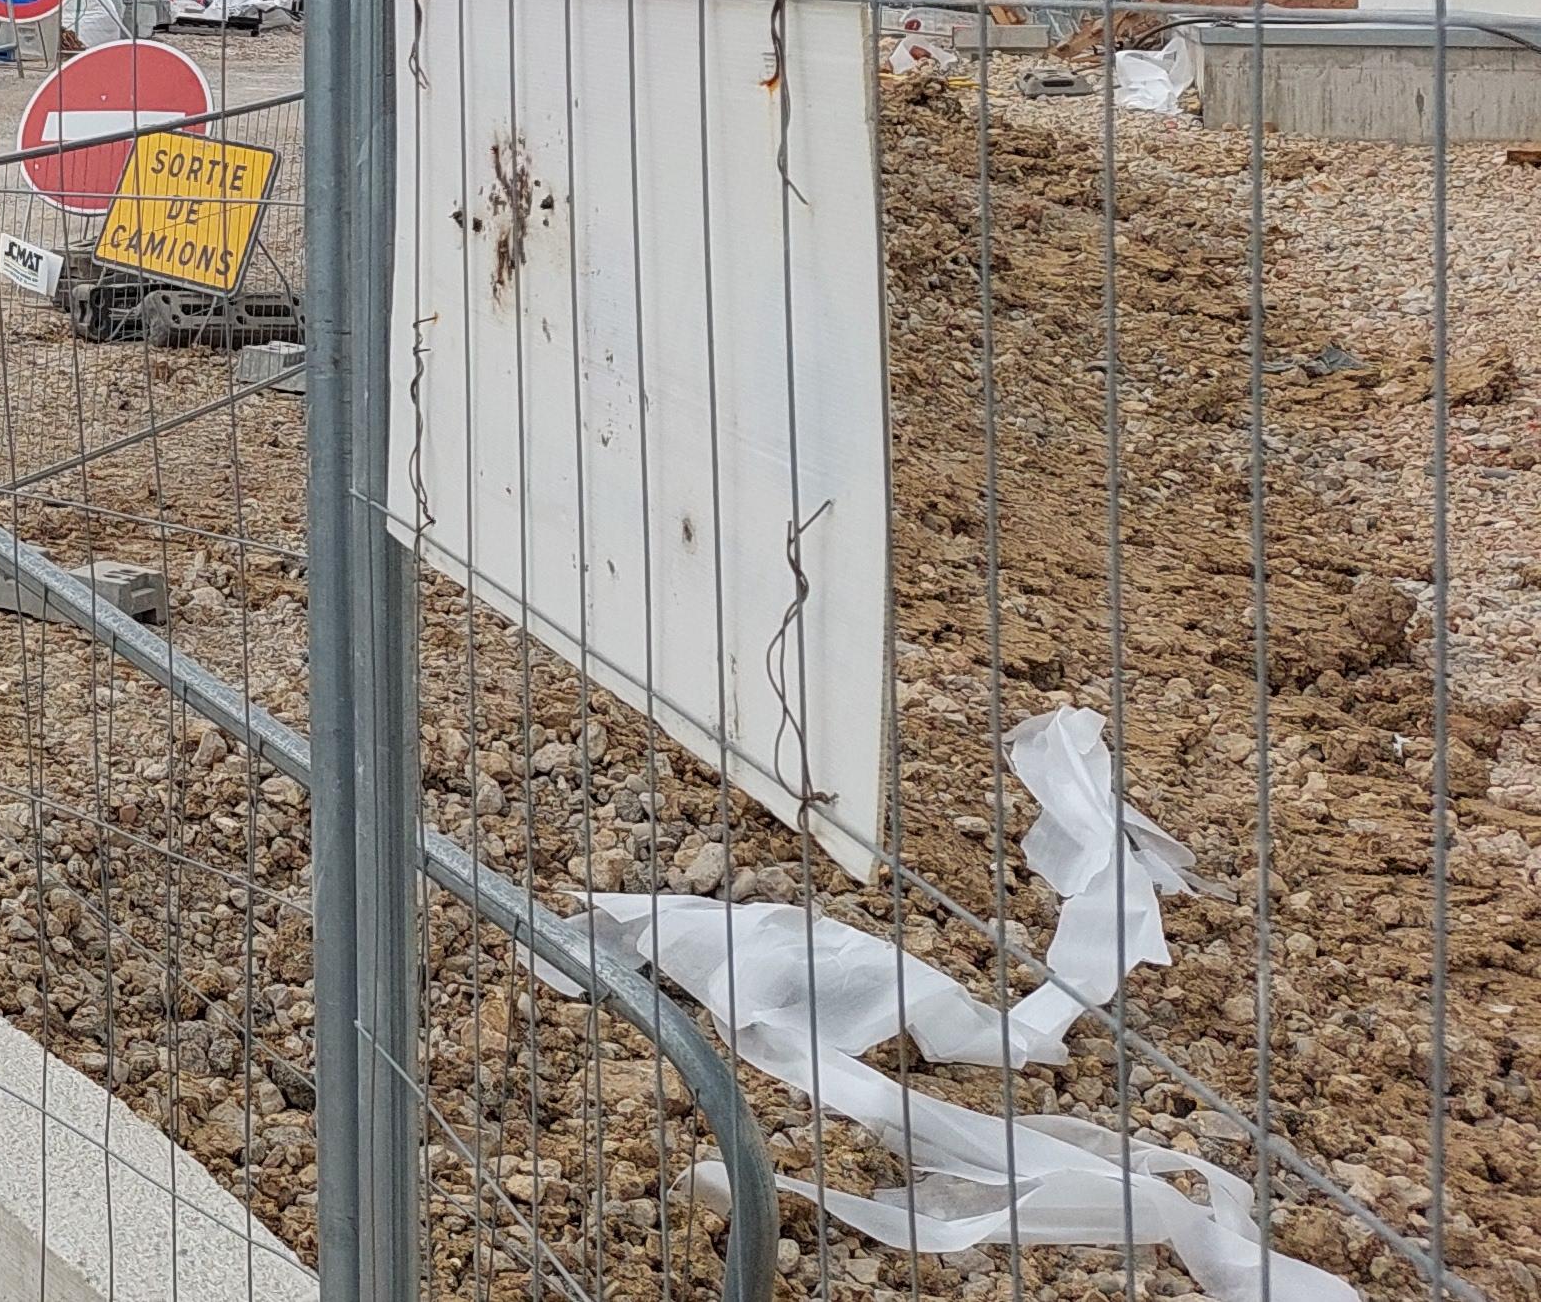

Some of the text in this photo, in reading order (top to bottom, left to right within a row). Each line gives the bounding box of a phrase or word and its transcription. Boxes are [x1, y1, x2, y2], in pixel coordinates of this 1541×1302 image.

[151, 149, 247, 191] SORTIE
[167, 195, 202, 225] DE
[5, 241, 43, 273] JCMAT
[110, 224, 234, 276] CAMIONS
